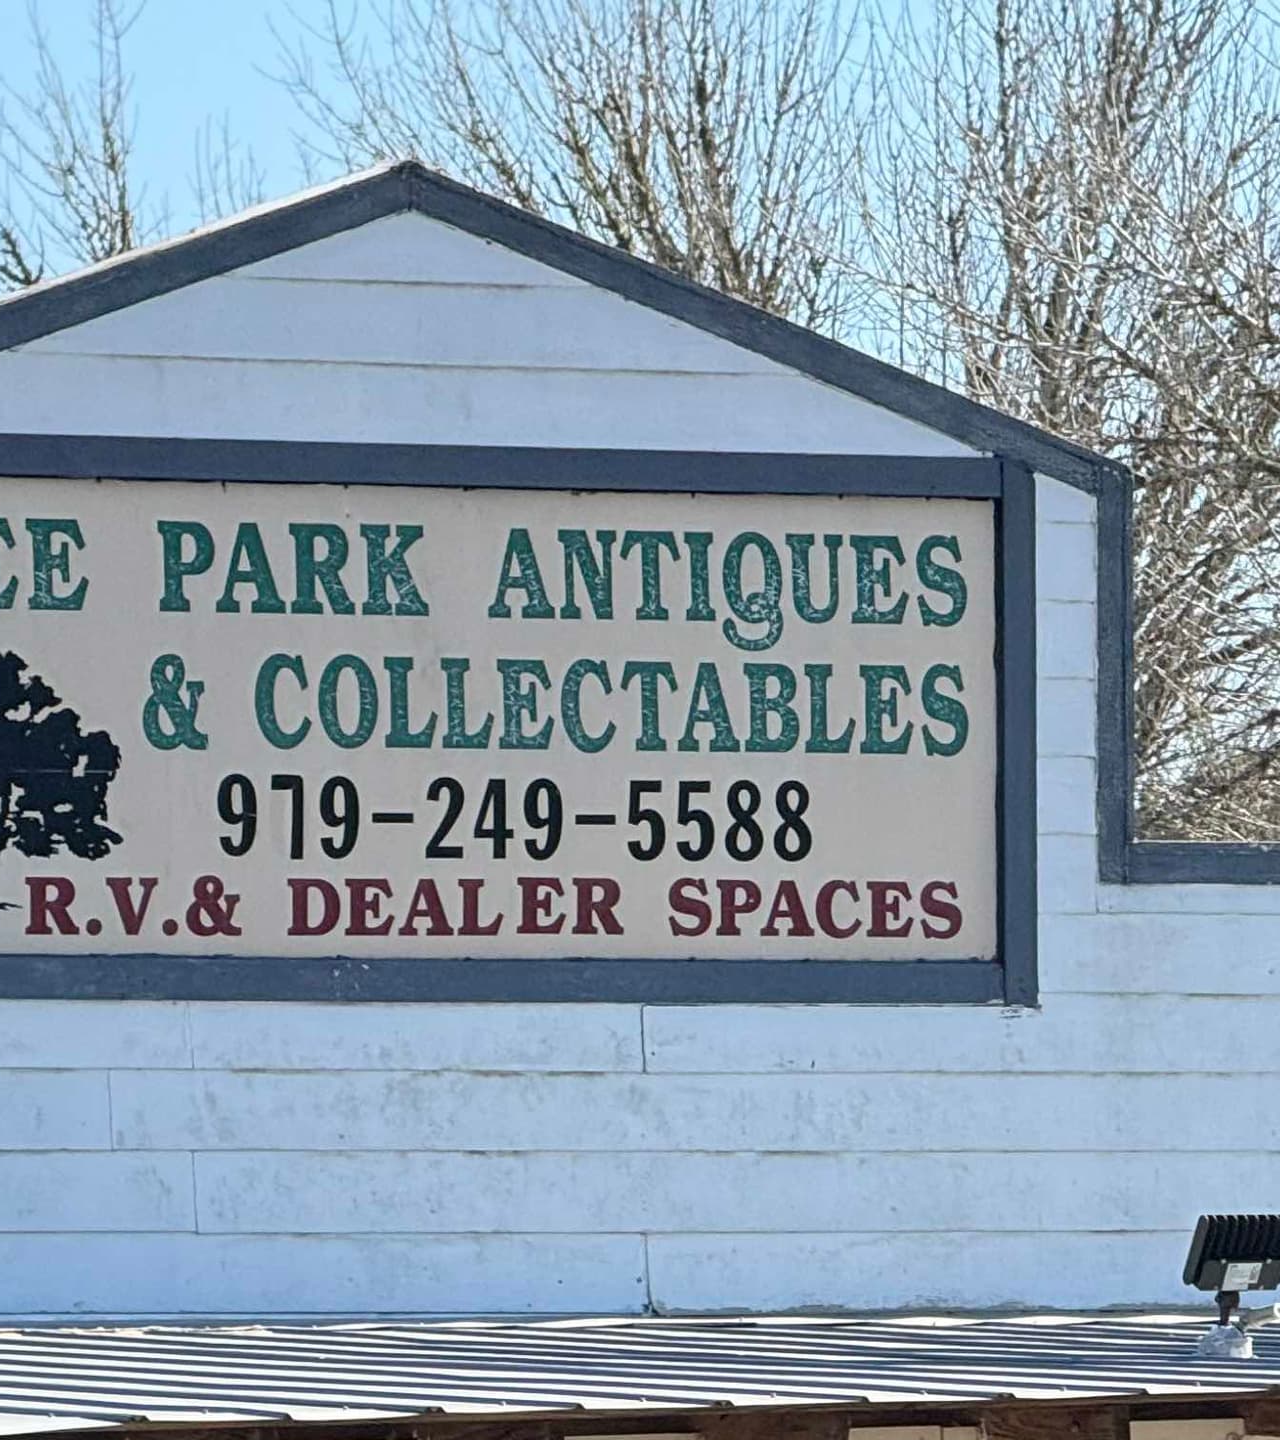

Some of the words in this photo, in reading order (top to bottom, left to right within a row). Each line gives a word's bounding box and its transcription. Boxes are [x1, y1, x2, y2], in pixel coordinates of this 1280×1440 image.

[157, 520, 429, 616] PARK
[488, 528, 969, 651] ANTIQUES
[143, 654, 209, 751] &
[255, 655, 969, 757] COLLECTABLES
[217, 773, 812, 862] 979-249-5588
[287, 877, 624, 936] DEALER
[668, 878, 963, 939] SPACES
